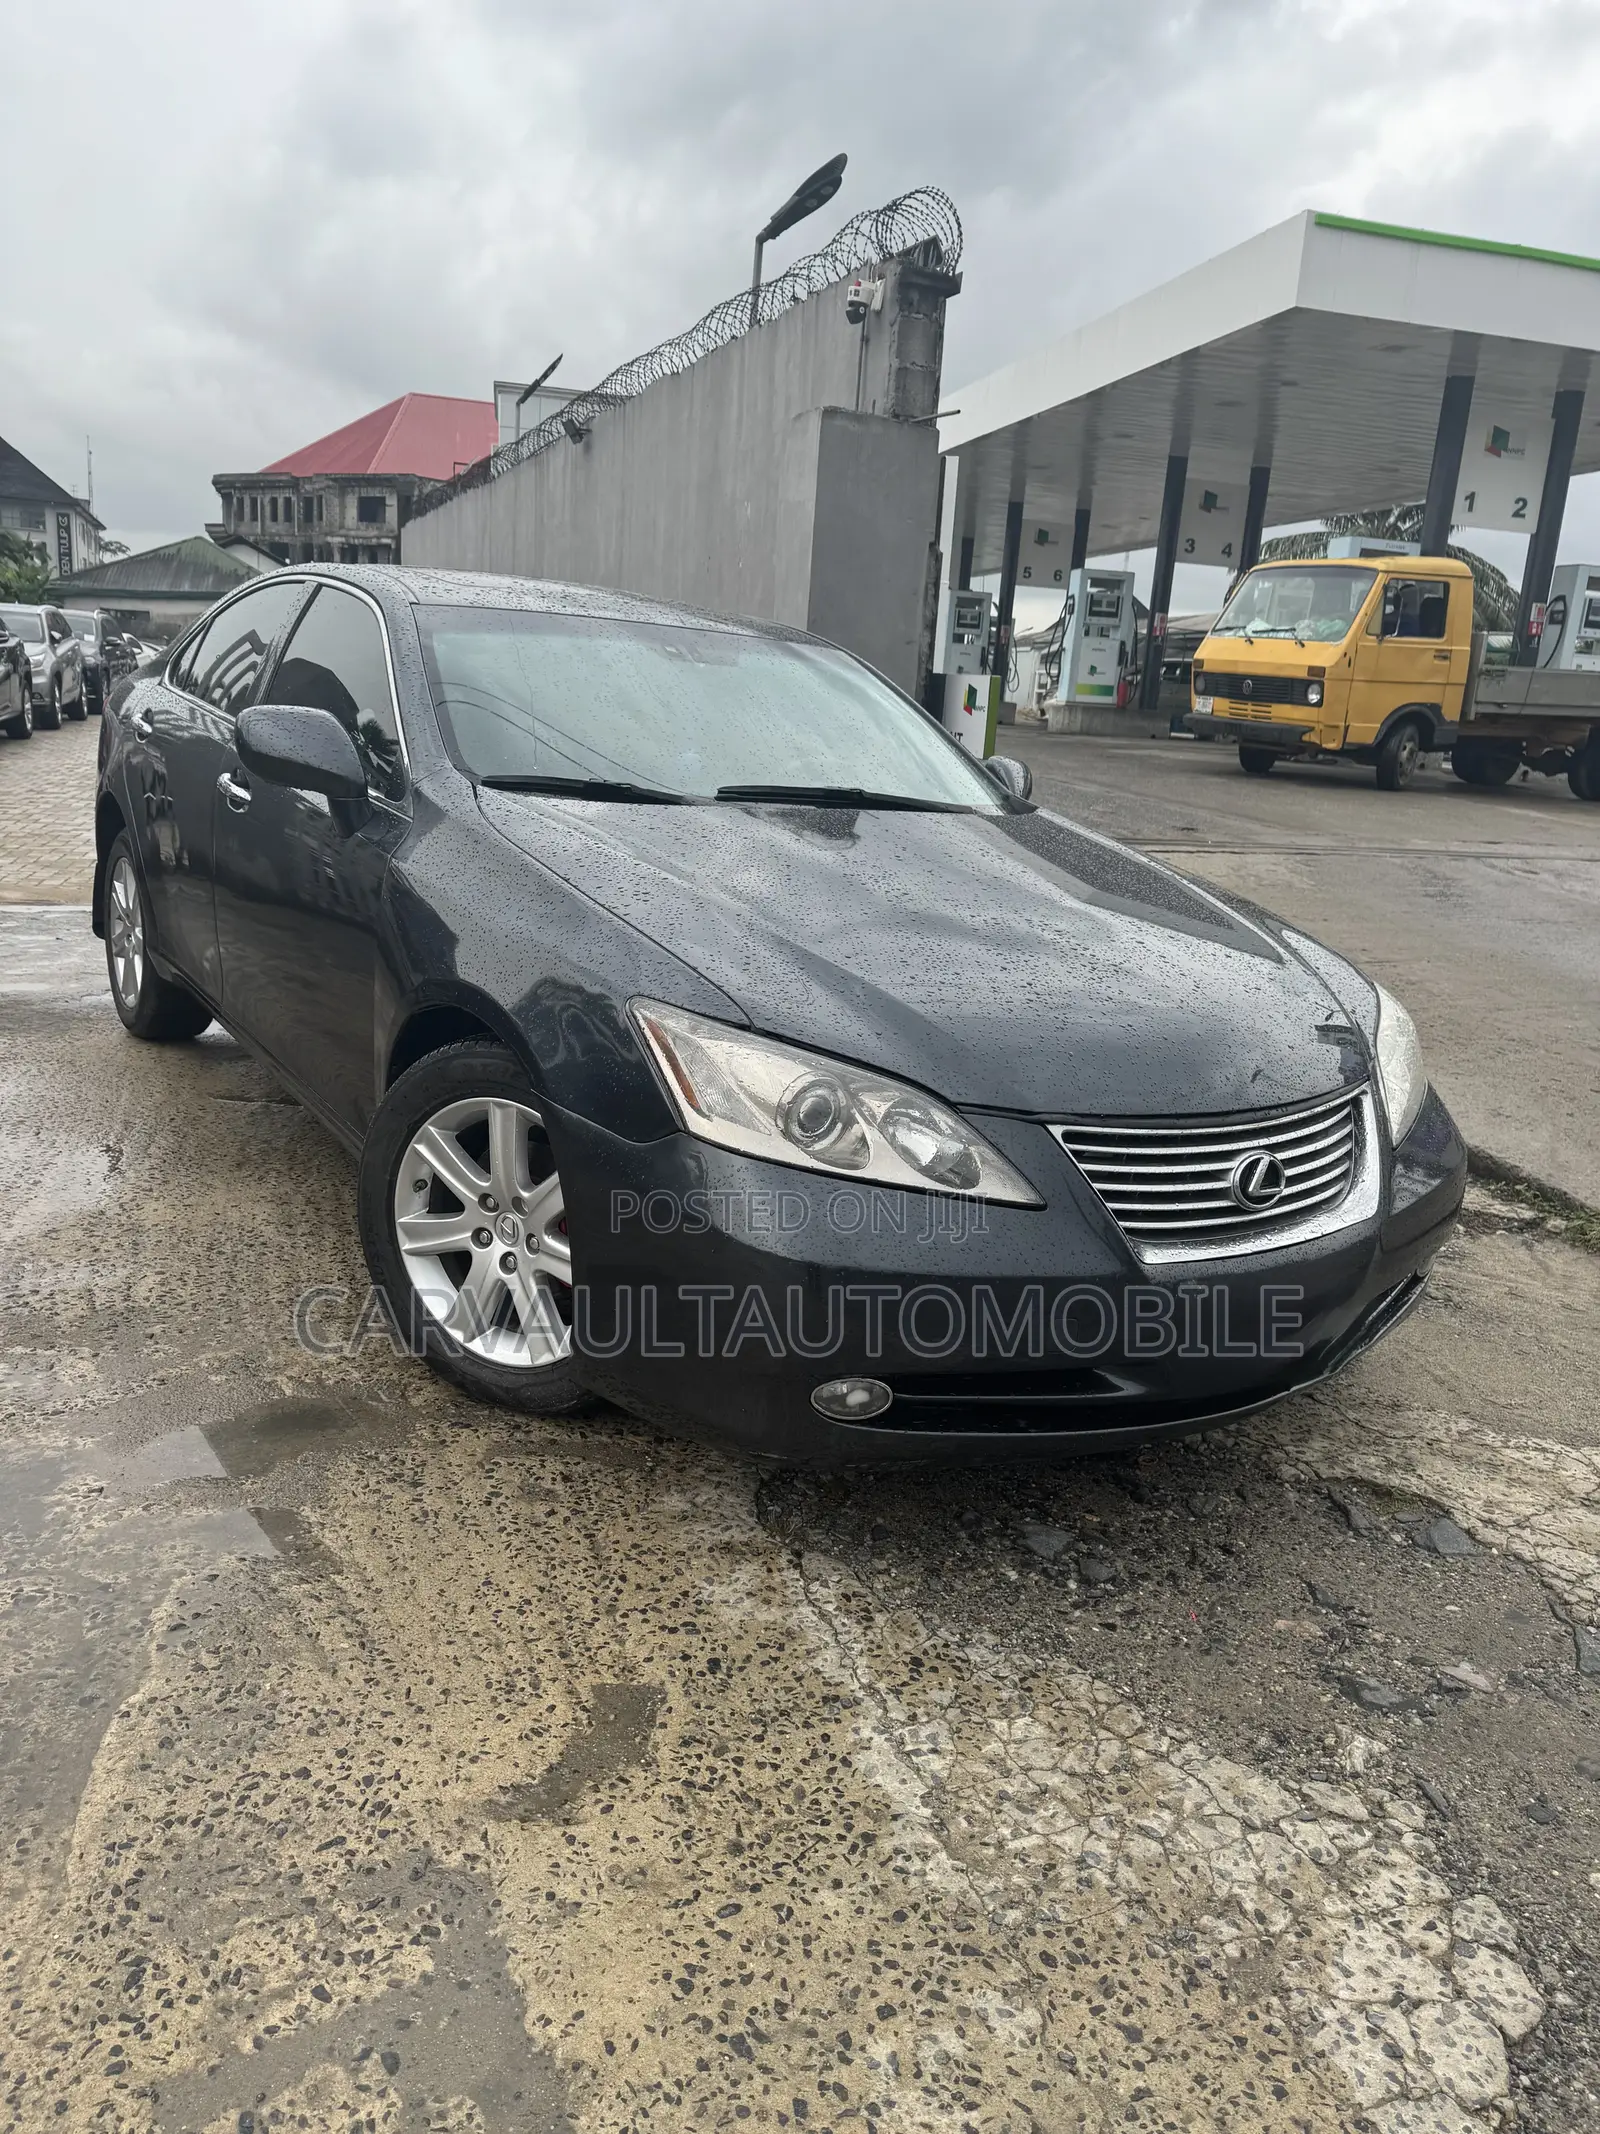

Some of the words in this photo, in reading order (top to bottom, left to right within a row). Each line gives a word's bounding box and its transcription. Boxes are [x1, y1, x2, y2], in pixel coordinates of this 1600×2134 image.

[1464, 491, 1476, 513] 1
[1511, 497, 1528, 518] 2
[1184, 538, 1195, 554] 3
[1221, 542, 1232, 558] 4
[1023, 566, 1032, 579] 5
[1053, 569, 1063, 582] 6
